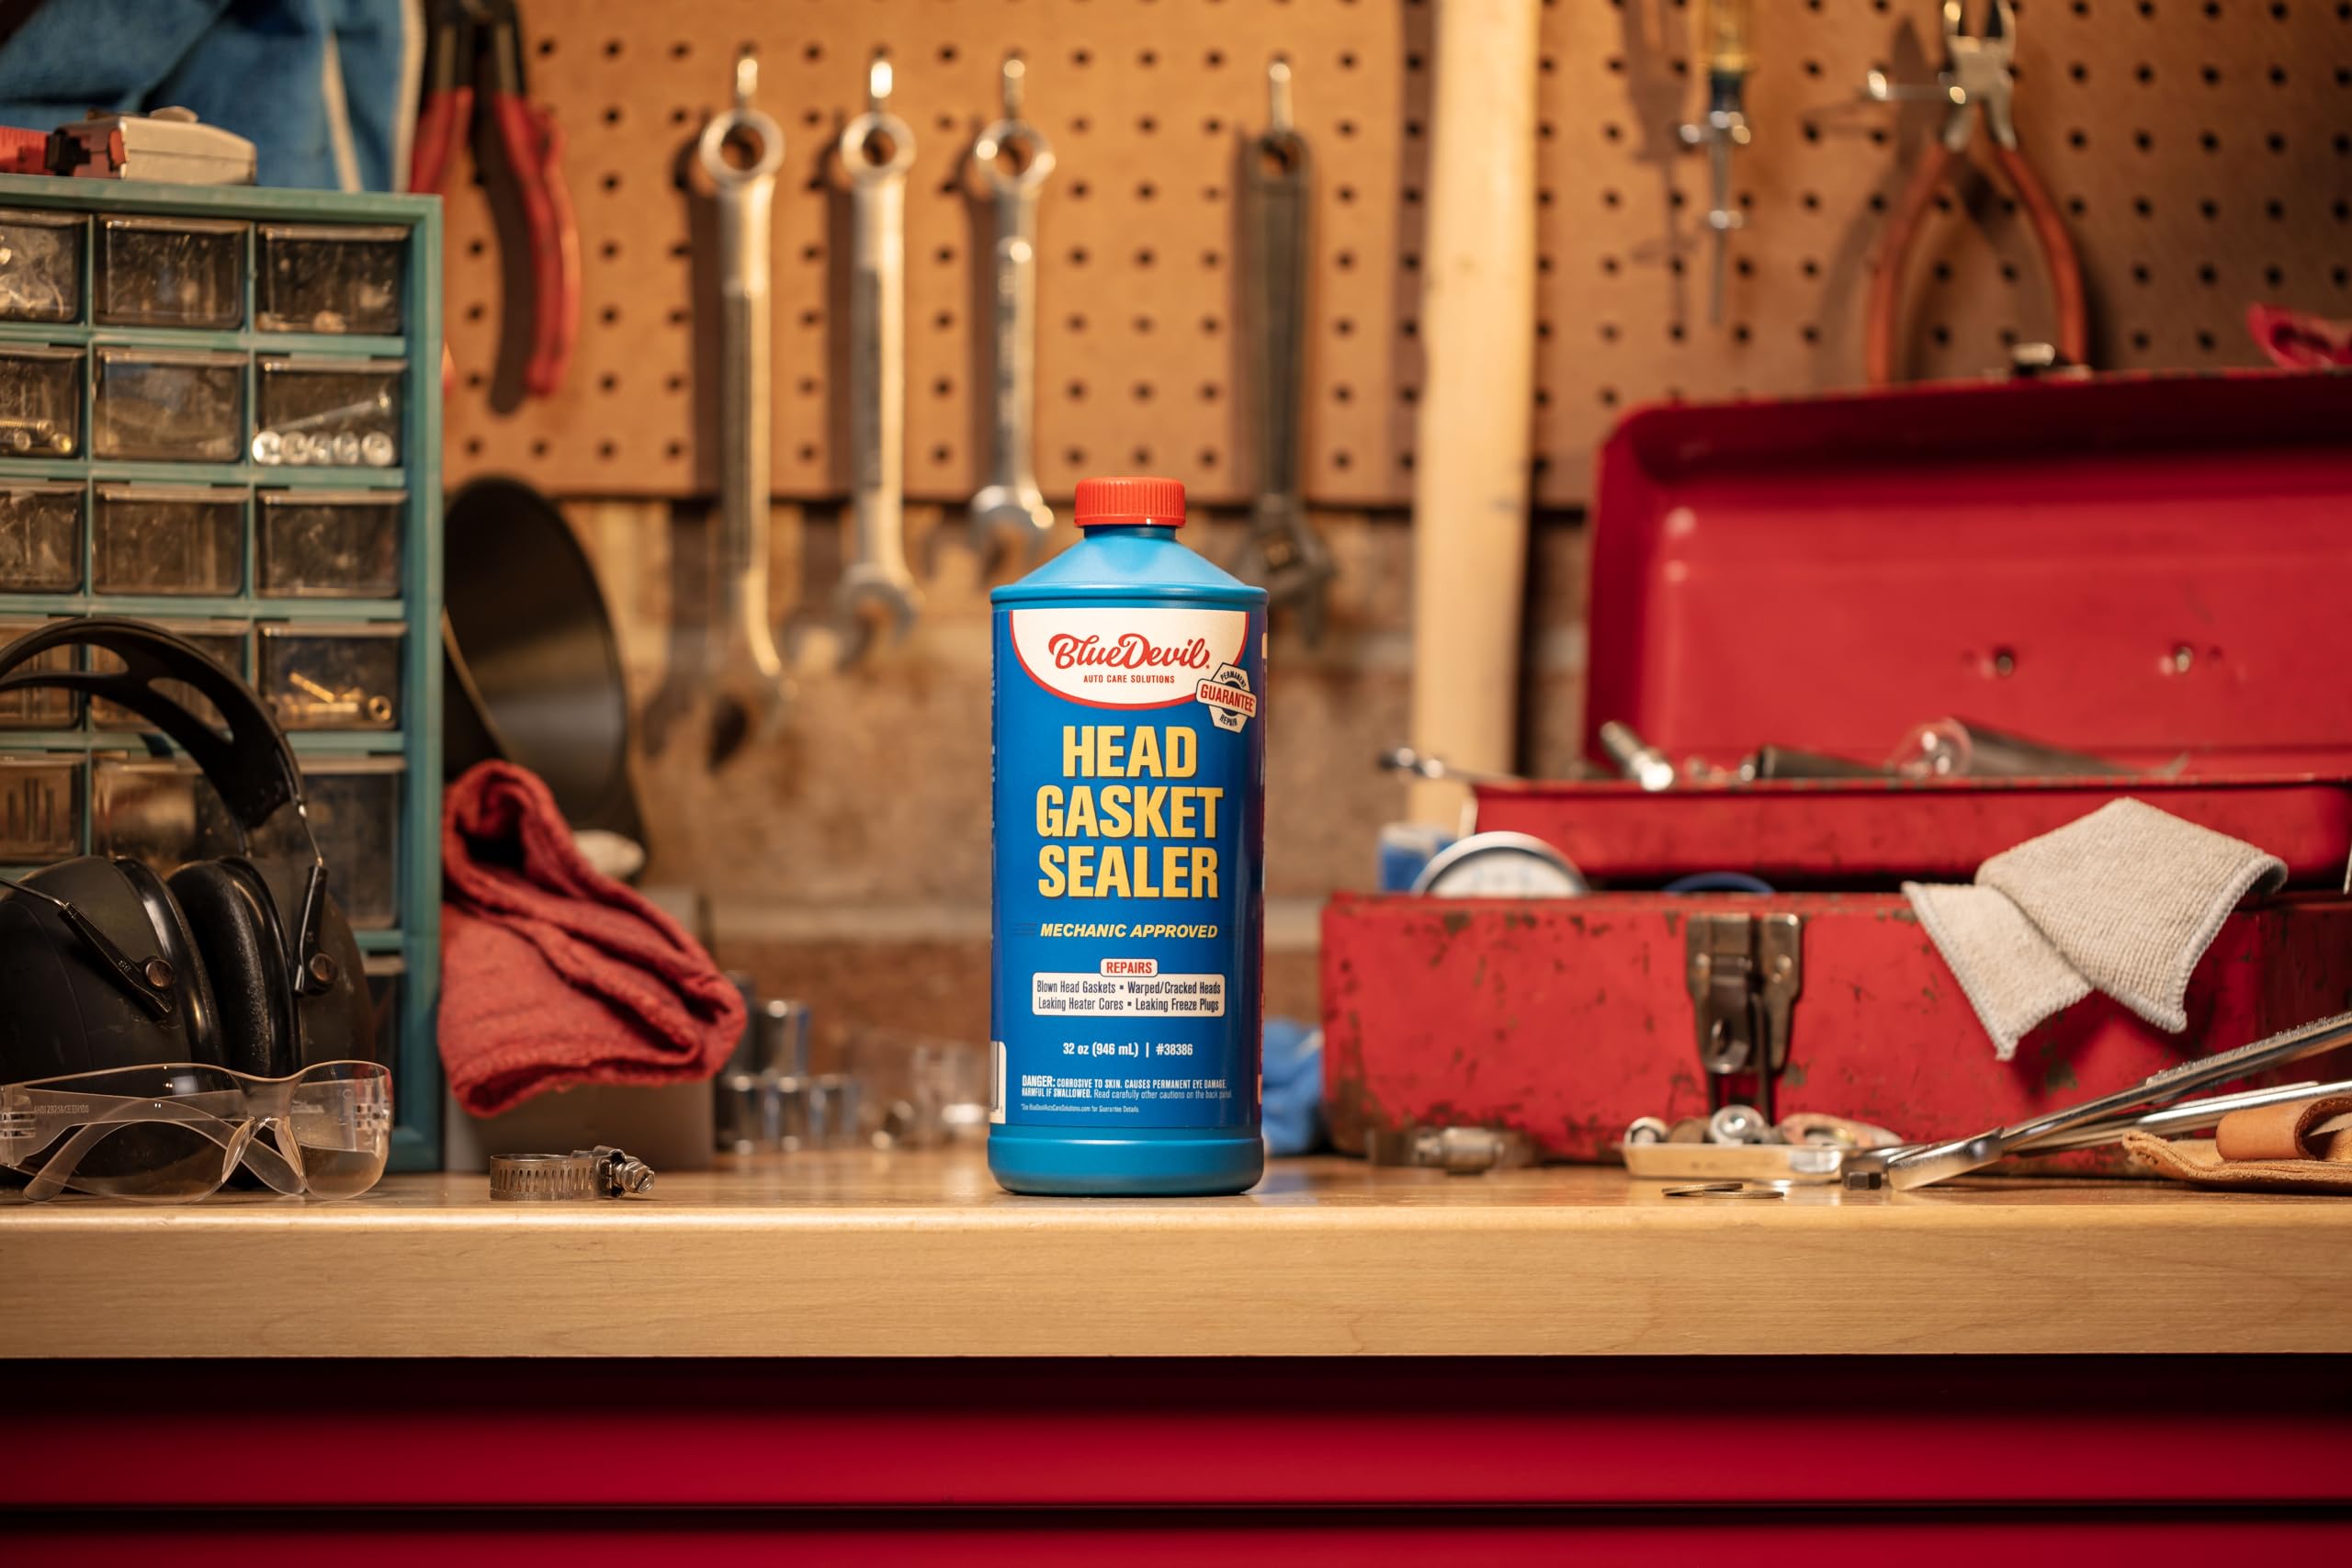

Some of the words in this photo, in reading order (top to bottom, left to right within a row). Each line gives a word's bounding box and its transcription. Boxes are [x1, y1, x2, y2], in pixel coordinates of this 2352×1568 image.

[1083, 674, 1103, 683] AUTO
[1106, 674, 1128, 683] CARE
[1130, 674, 1175, 683] SOLUTIONS
[1220, 671, 1247, 688] PERMANENT
[1200, 683, 1256, 714] GUARANTEE
[1219, 714, 1238, 728] REPAIR
[1062, 725, 1198, 778] HEAD
[1035, 784, 1224, 839] GASKET
[1037, 844, 1219, 898] SEALER
[1040, 923, 1127, 938] MECHANIC
[1129, 924, 1219, 939] APPROVED
[1105, 961, 1153, 975] REPAIRS
[1036, 979, 1058, 993] Blown
[1059, 980, 1080, 993] Head
[1082, 980, 1116, 994] Gaskets
[1127, 981, 1197, 997] Warped/Cracked
[1199, 981, 1221, 994] Heads
[1038, 997, 1066, 1011] Leaking
[1069, 997, 1096, 1010] Heater
[1098, 998, 1124, 1010] Cores
[1136, 998, 1169, 1013] Leaking
[1171, 998, 1198, 1011] Freeze
[1199, 998, 1220, 1013] Plugs
[1062, 1042, 1075, 1055] 32
[1077, 1044, 1090, 1055] oz
[1091, 1041, 1115, 1057] (946
[1118, 1042, 1139, 1057] mL)
[1155, 1043, 1193, 1055] #38386
[1022, 1075, 1056, 1088] DANGER:
[1057, 1078, 1093, 1089] CORROSIVE
[1094, 1078, 1103, 1089] TO
[1104, 1078, 1123, 1089] SKIN.
[1124, 1079, 1151, 1089] CAUSES
[1152, 1079, 1192, 1089] PERMANENT
[1193, 1079, 1204, 1089] EYE
[1022, 1088, 1046, 1097] HARMFUL
[1046, 1088, 1052, 1098] IF
[1053, 1089, 1092, 1099] SWALLOWED.
[1093, 1089, 1110, 1099] Read
[1111, 1089, 1139, 1100] carefully
[1140, 1089, 1158, 1100] other
[1159, 1090, 1185, 1100] cautions
[1186, 1091, 1194, 1100] on
[1195, 1090, 1204, 1100] the
